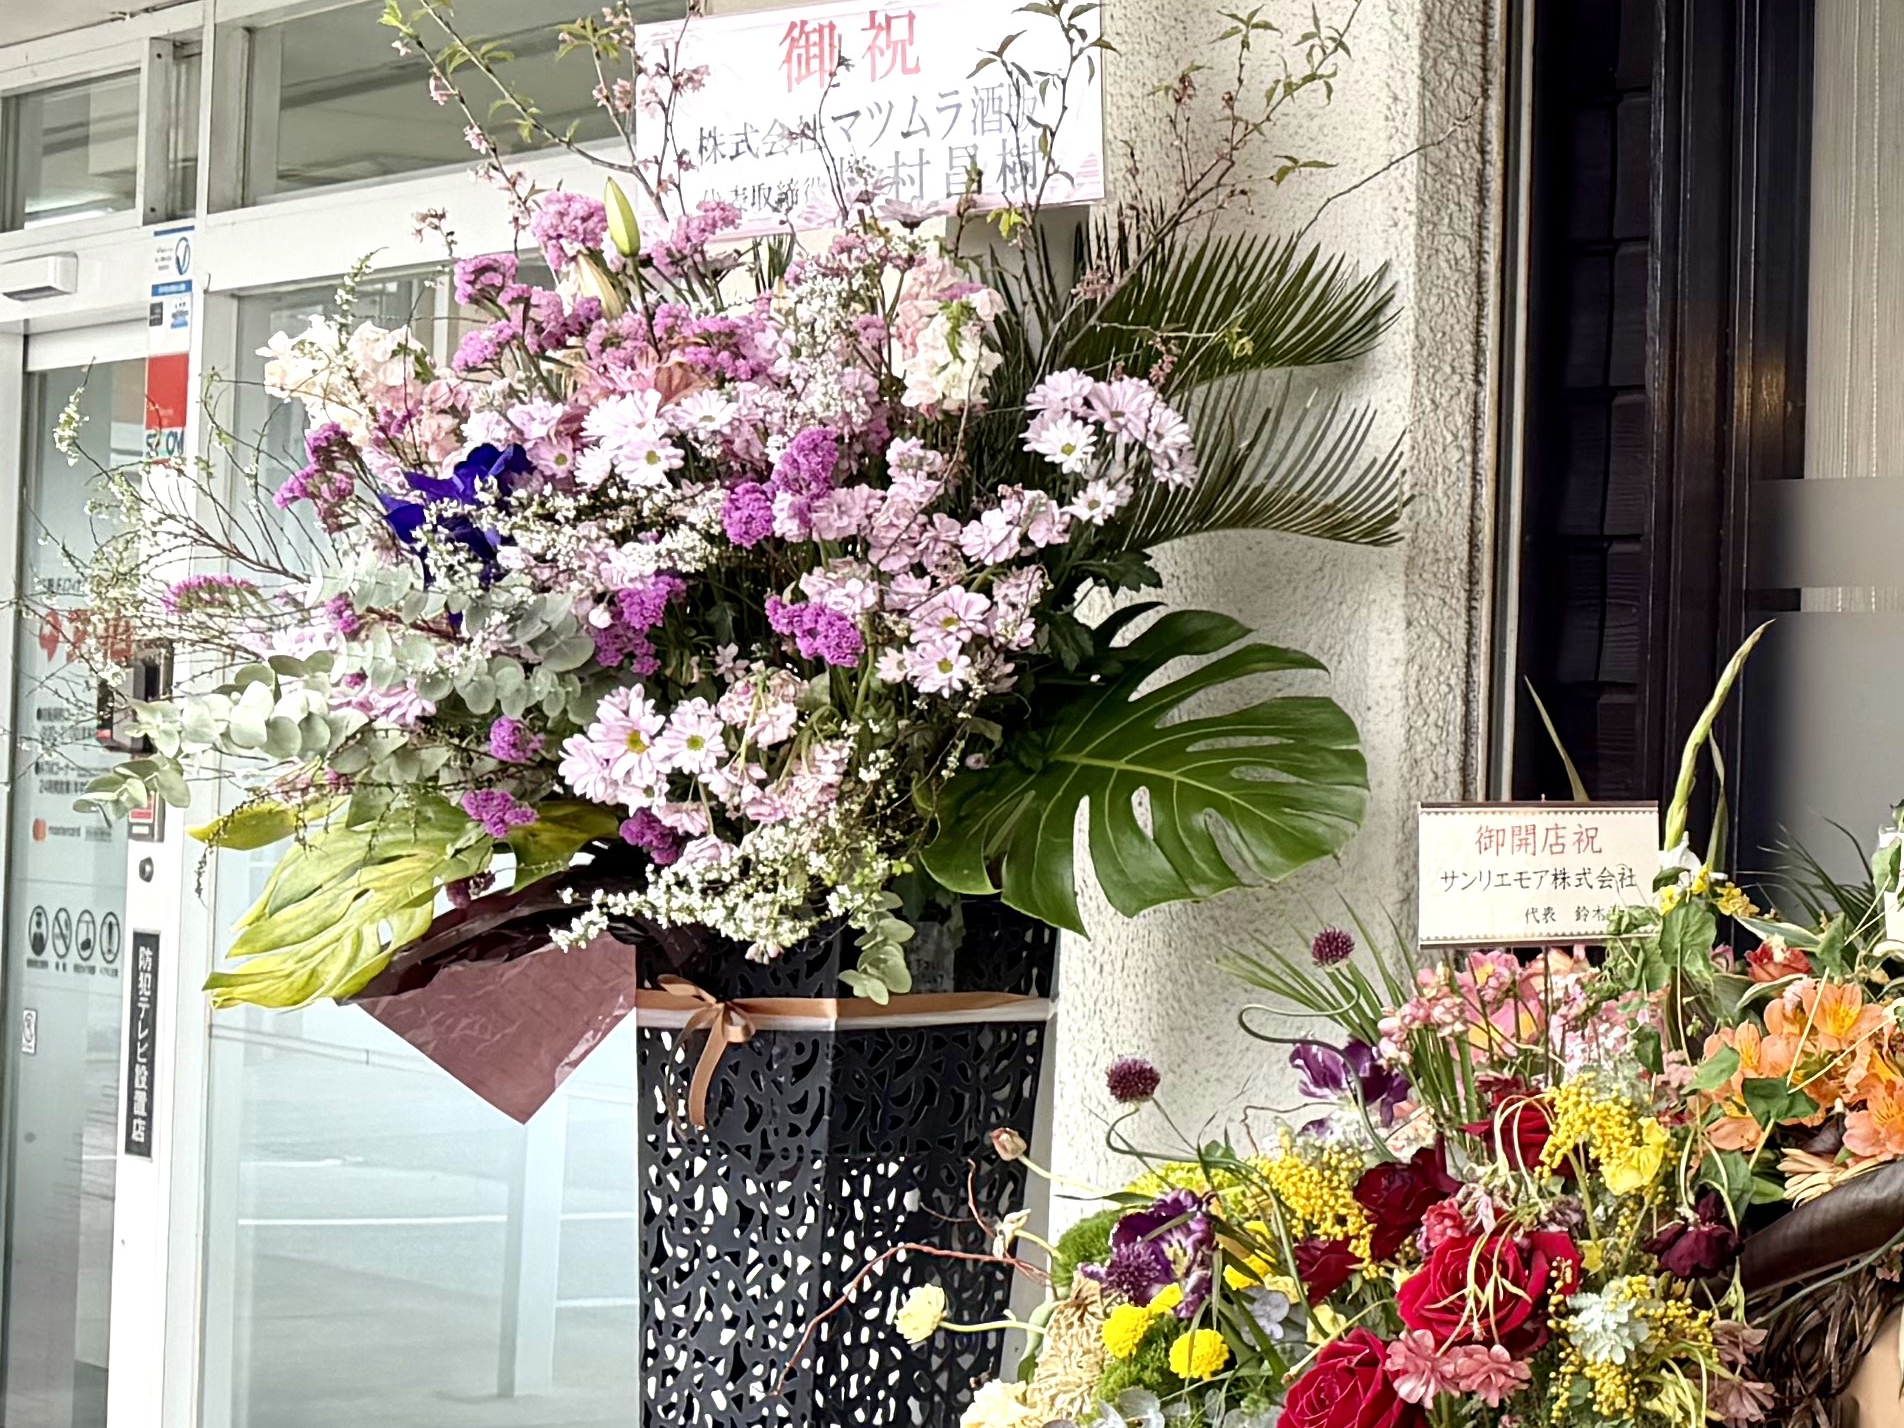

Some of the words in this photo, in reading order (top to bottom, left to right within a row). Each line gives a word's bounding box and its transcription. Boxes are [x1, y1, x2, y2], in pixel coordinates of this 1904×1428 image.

[779, 9, 921, 94] 御祝
[1475, 823, 1602, 857] 御開店祝
[1440, 865, 1637, 892] サンリエモア株式会社
[1525, 907, 1557, 924] 代表
[130, 946, 154, 1143] 防犯テレビ設置店
